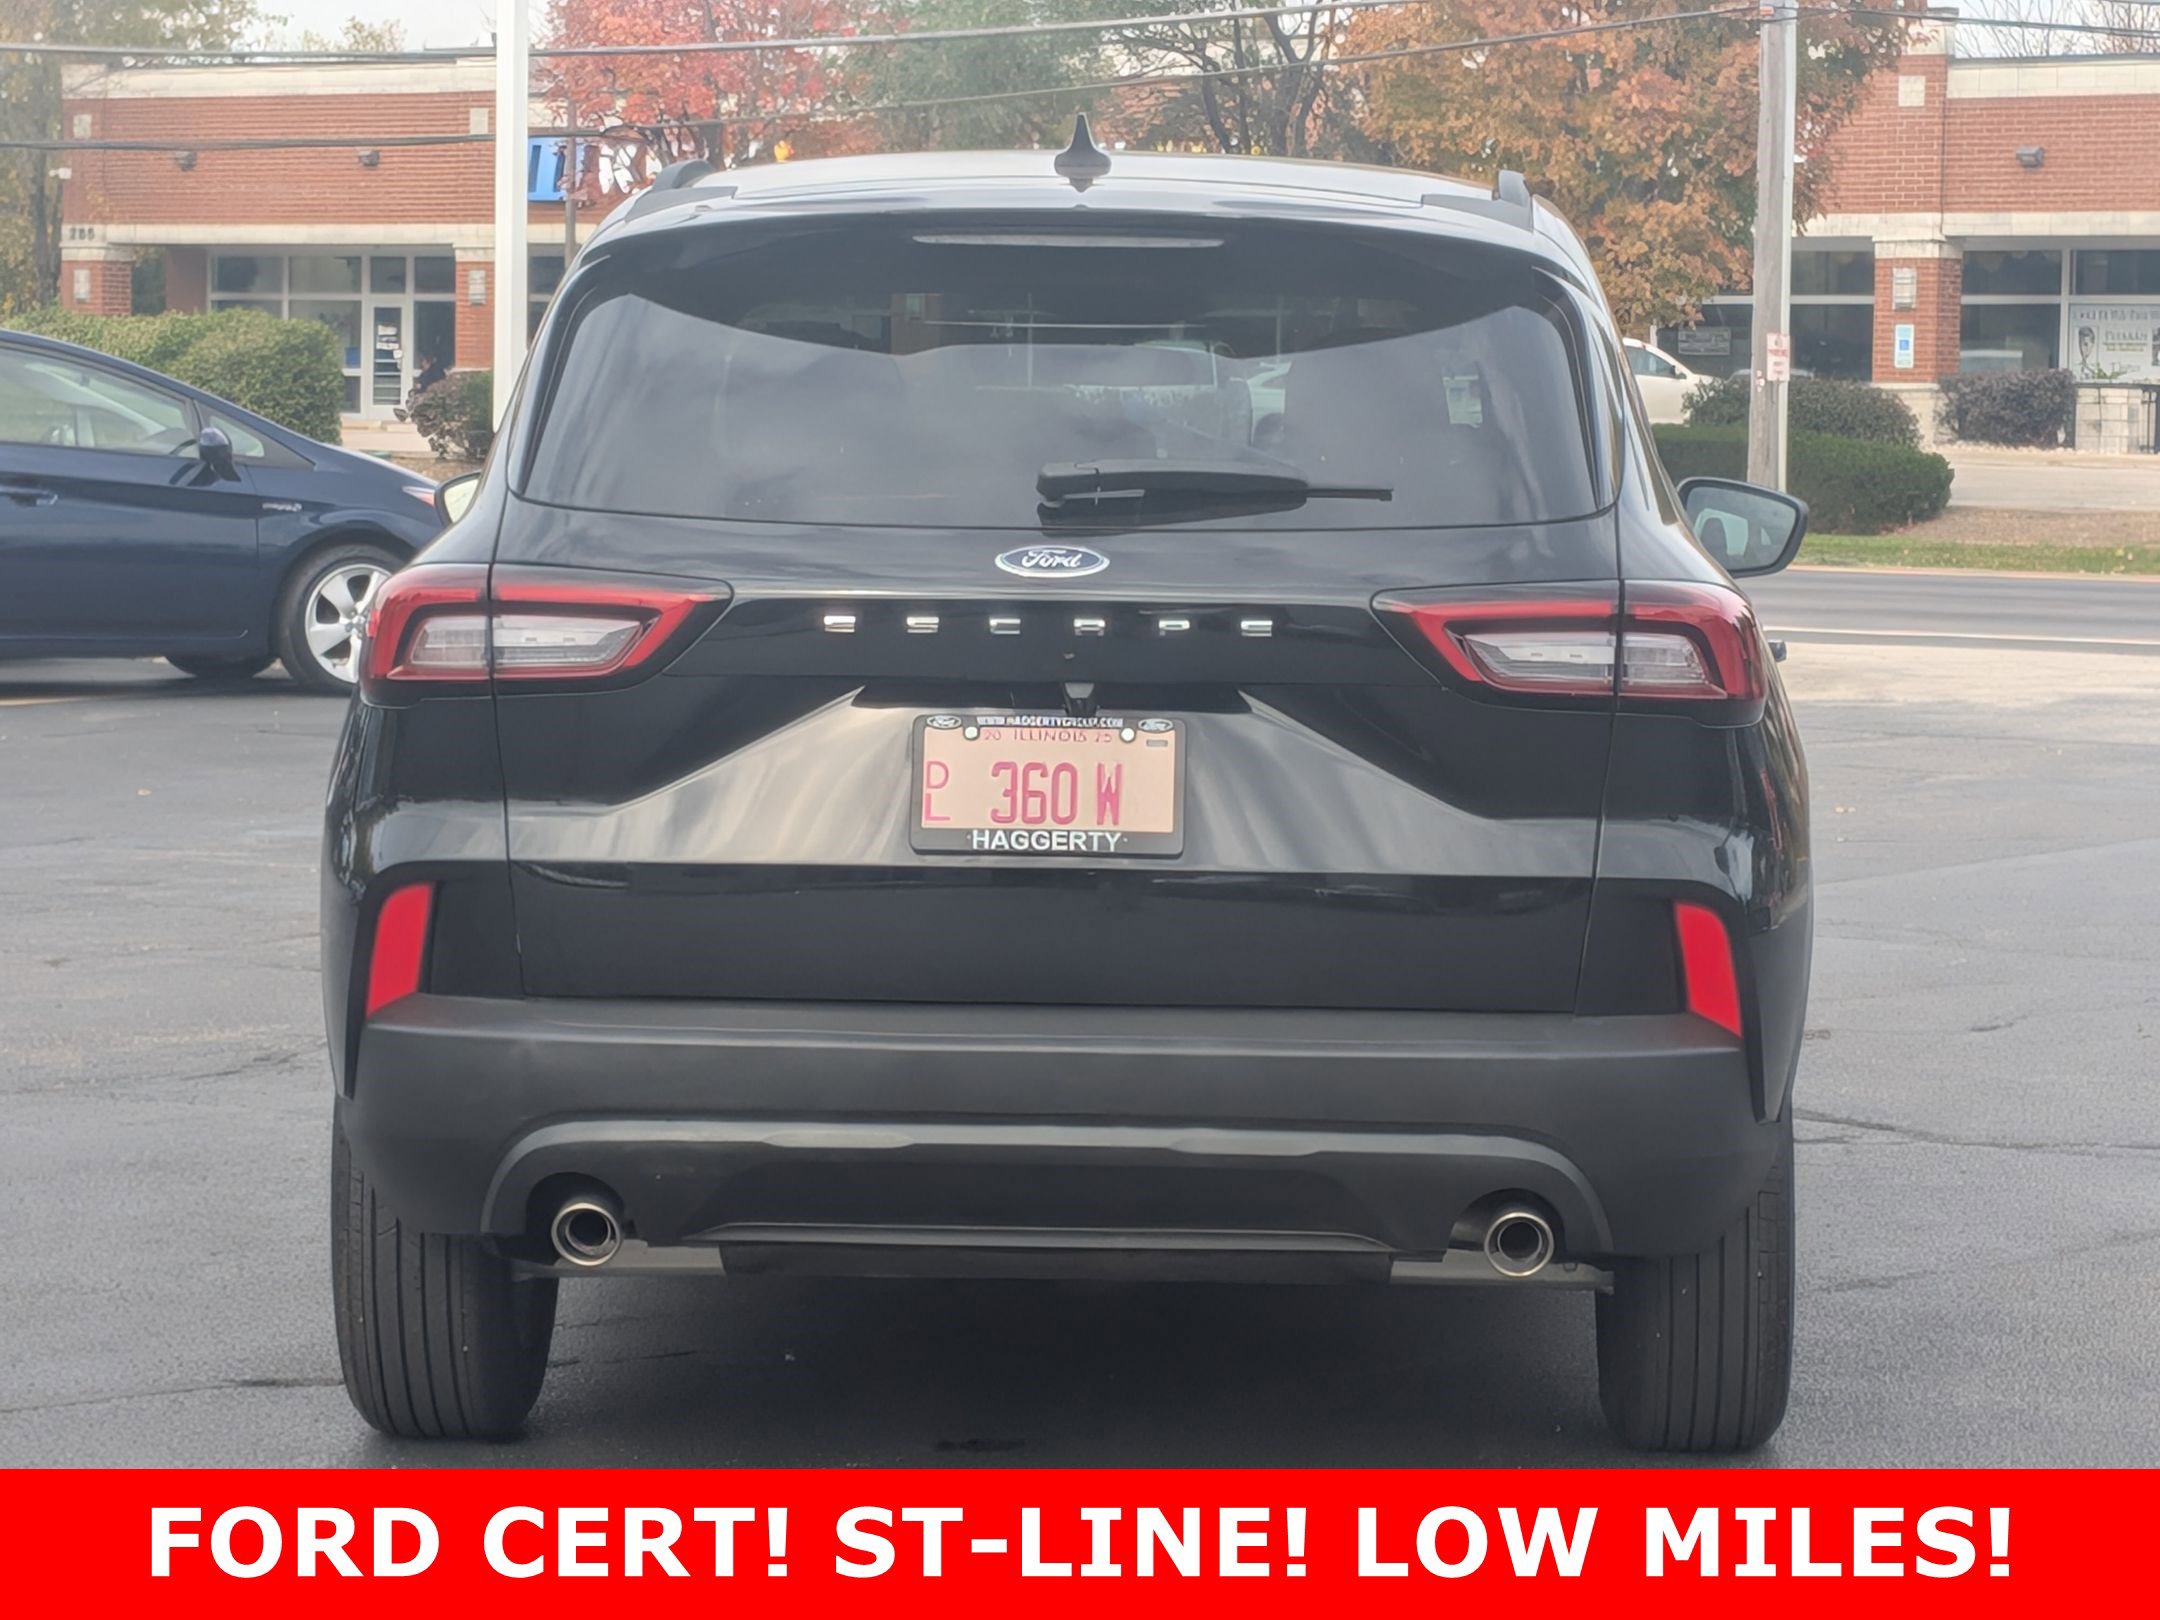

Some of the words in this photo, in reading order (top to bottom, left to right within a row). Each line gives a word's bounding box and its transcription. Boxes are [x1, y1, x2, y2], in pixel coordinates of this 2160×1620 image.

[1021, 549, 1082, 568] Ford
[1013, 729, 1088, 742] ILLINOIS
[990, 761, 1078, 825] 360
[1096, 762, 1123, 826] W
[972, 829, 1122, 852] HAGGERTY
